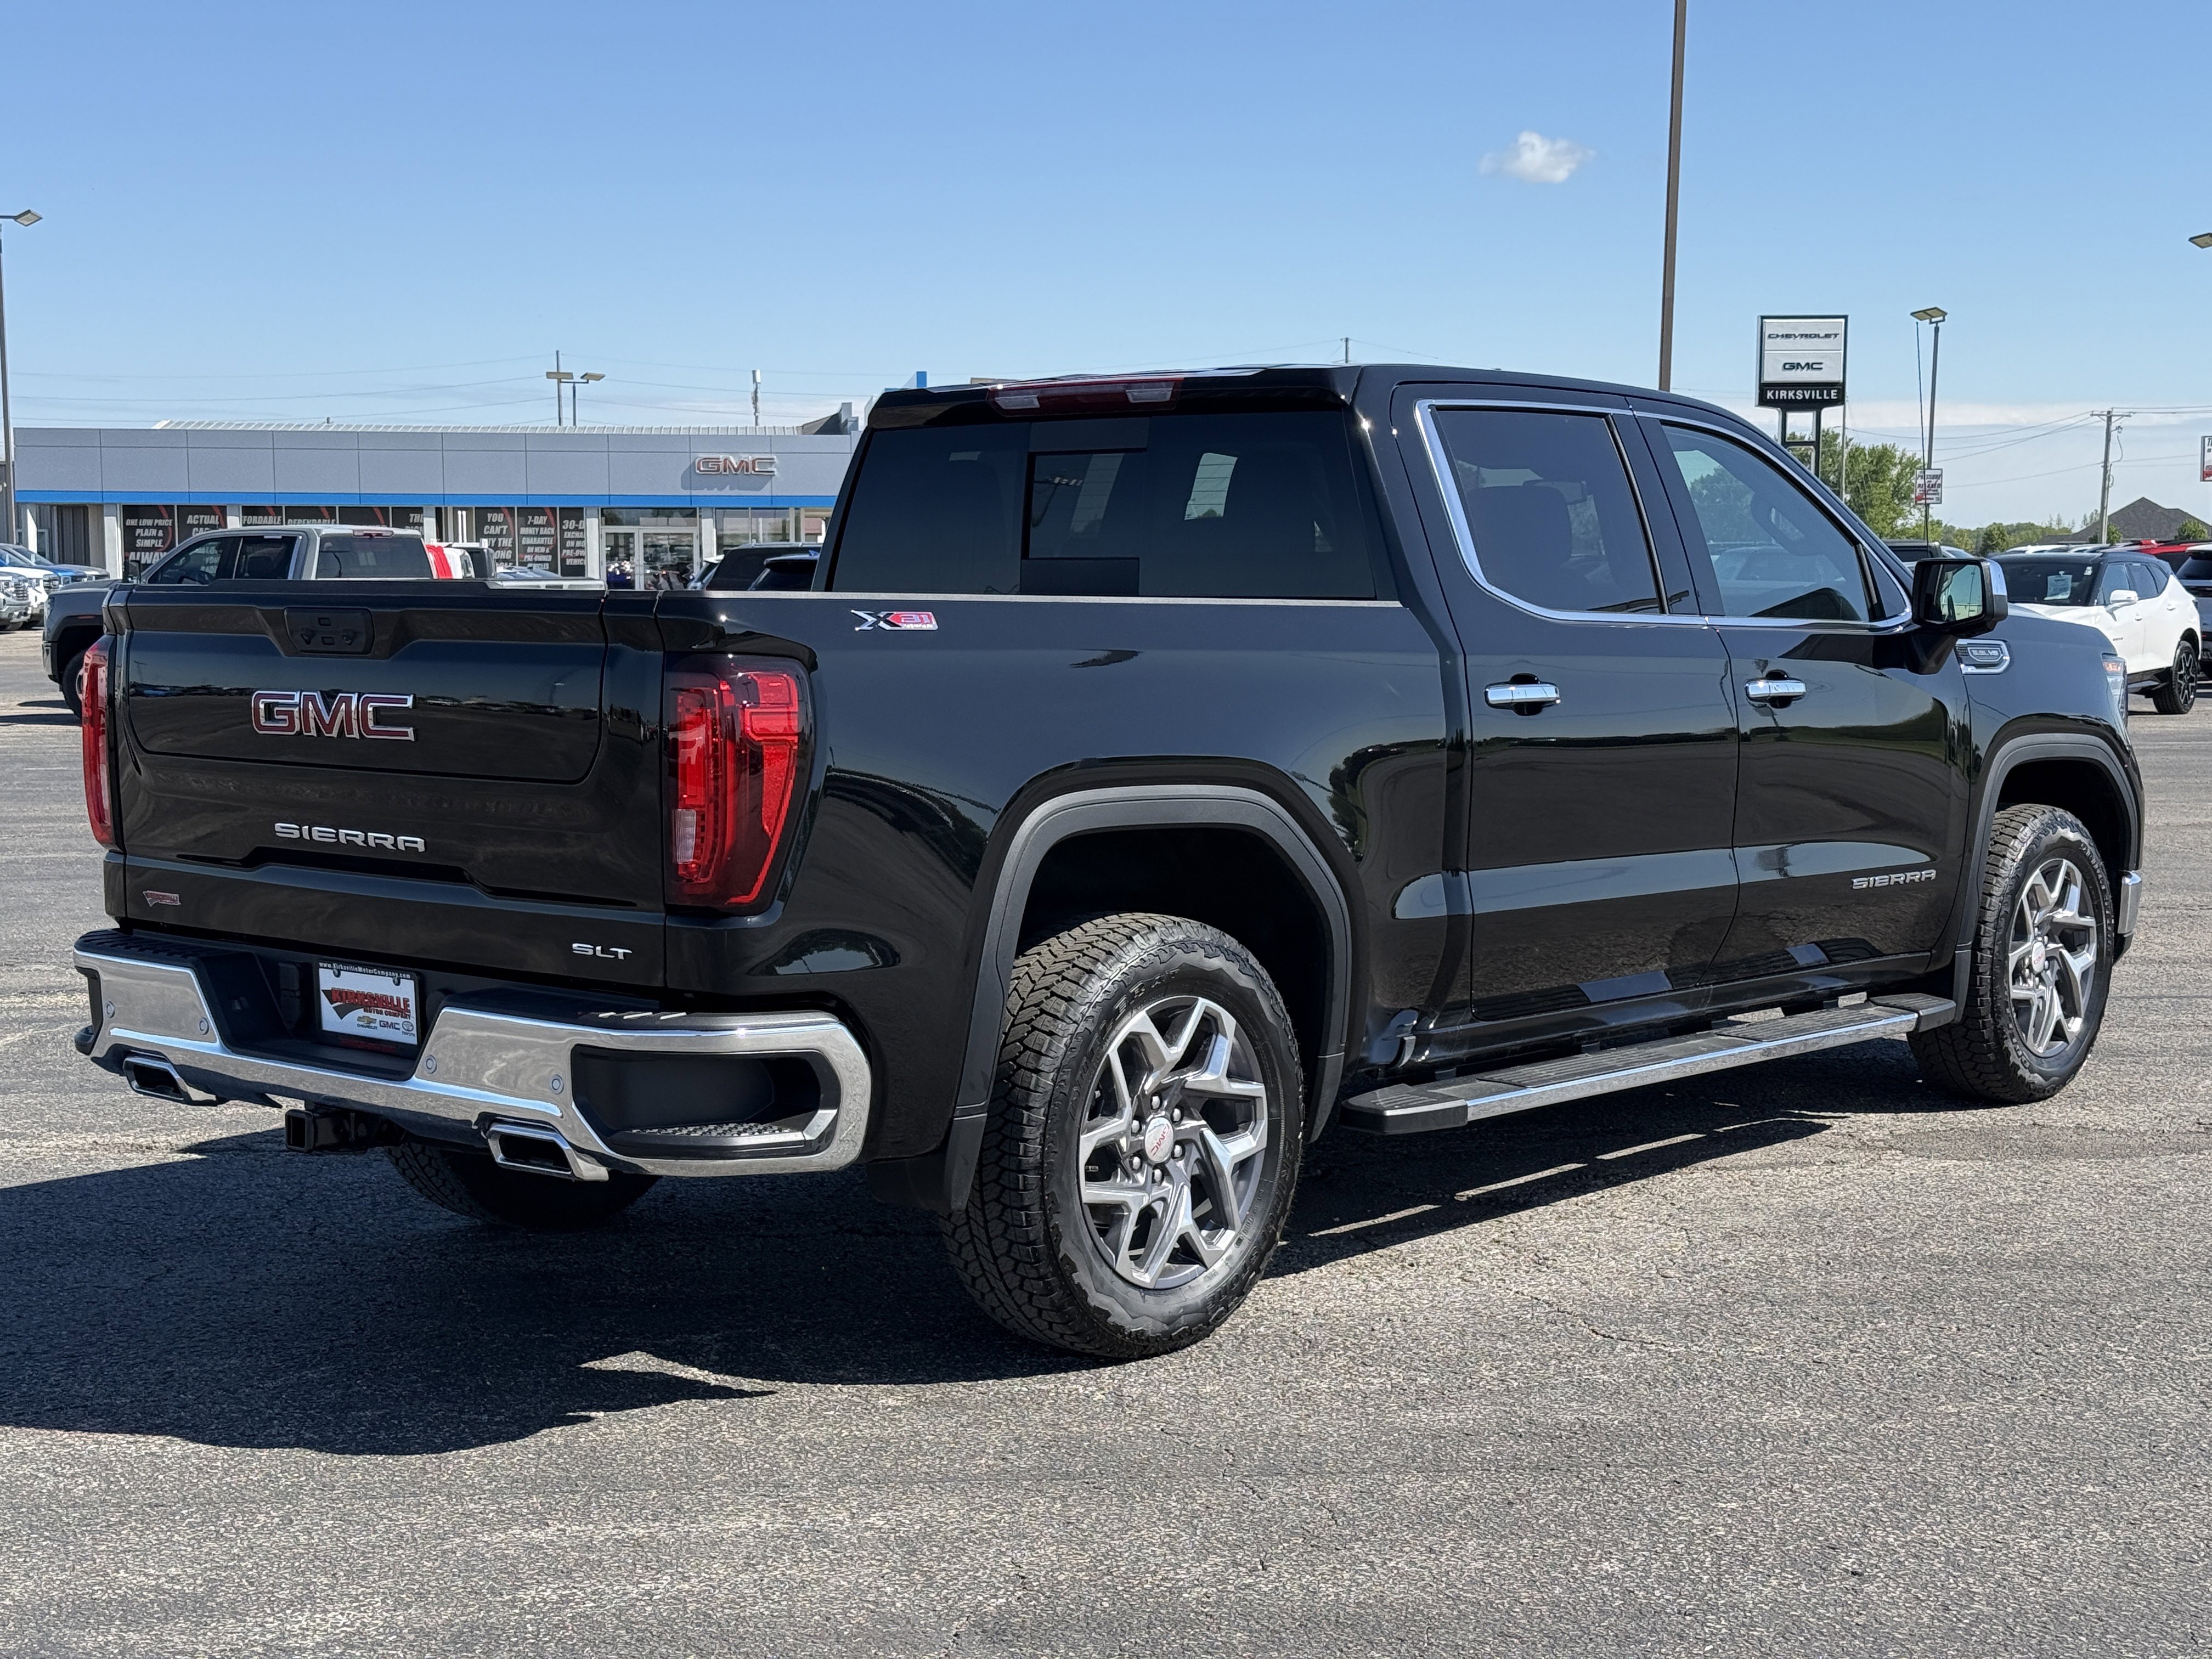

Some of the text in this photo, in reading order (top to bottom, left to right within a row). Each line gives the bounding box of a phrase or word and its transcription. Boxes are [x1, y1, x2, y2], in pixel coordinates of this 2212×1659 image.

[1782, 362, 1824, 371] GMC
[1767, 390, 1838, 399] KIRKSVILLE
[696, 455, 777, 475] GMC
[187, 515, 219, 525] ACTUAL
[487, 513, 504, 523] YOU
[527, 516, 548, 525] 7-DAY
[136, 528, 157, 537] PLAIN
[483, 525, 508, 535] CAN'T
[539, 527, 555, 535] BACK
[480, 538, 513, 547] UY THE
[494, 550, 512, 560] ONG
[251, 690, 415, 742] GMC
[275, 823, 425, 852] SIERRA
[1851, 870, 1937, 889] SIERRA
[572, 943, 633, 960] SLT
[319, 962, 411, 979] www.KirksvilleMotorCompany.com
[331, 987, 410, 1013] KIRKSVILLE
[363, 1007, 411, 1020] MOTOR COMPANY
[379, 1019, 400, 1030] GMC
[1150, 1124, 1170, 1156] GMC
